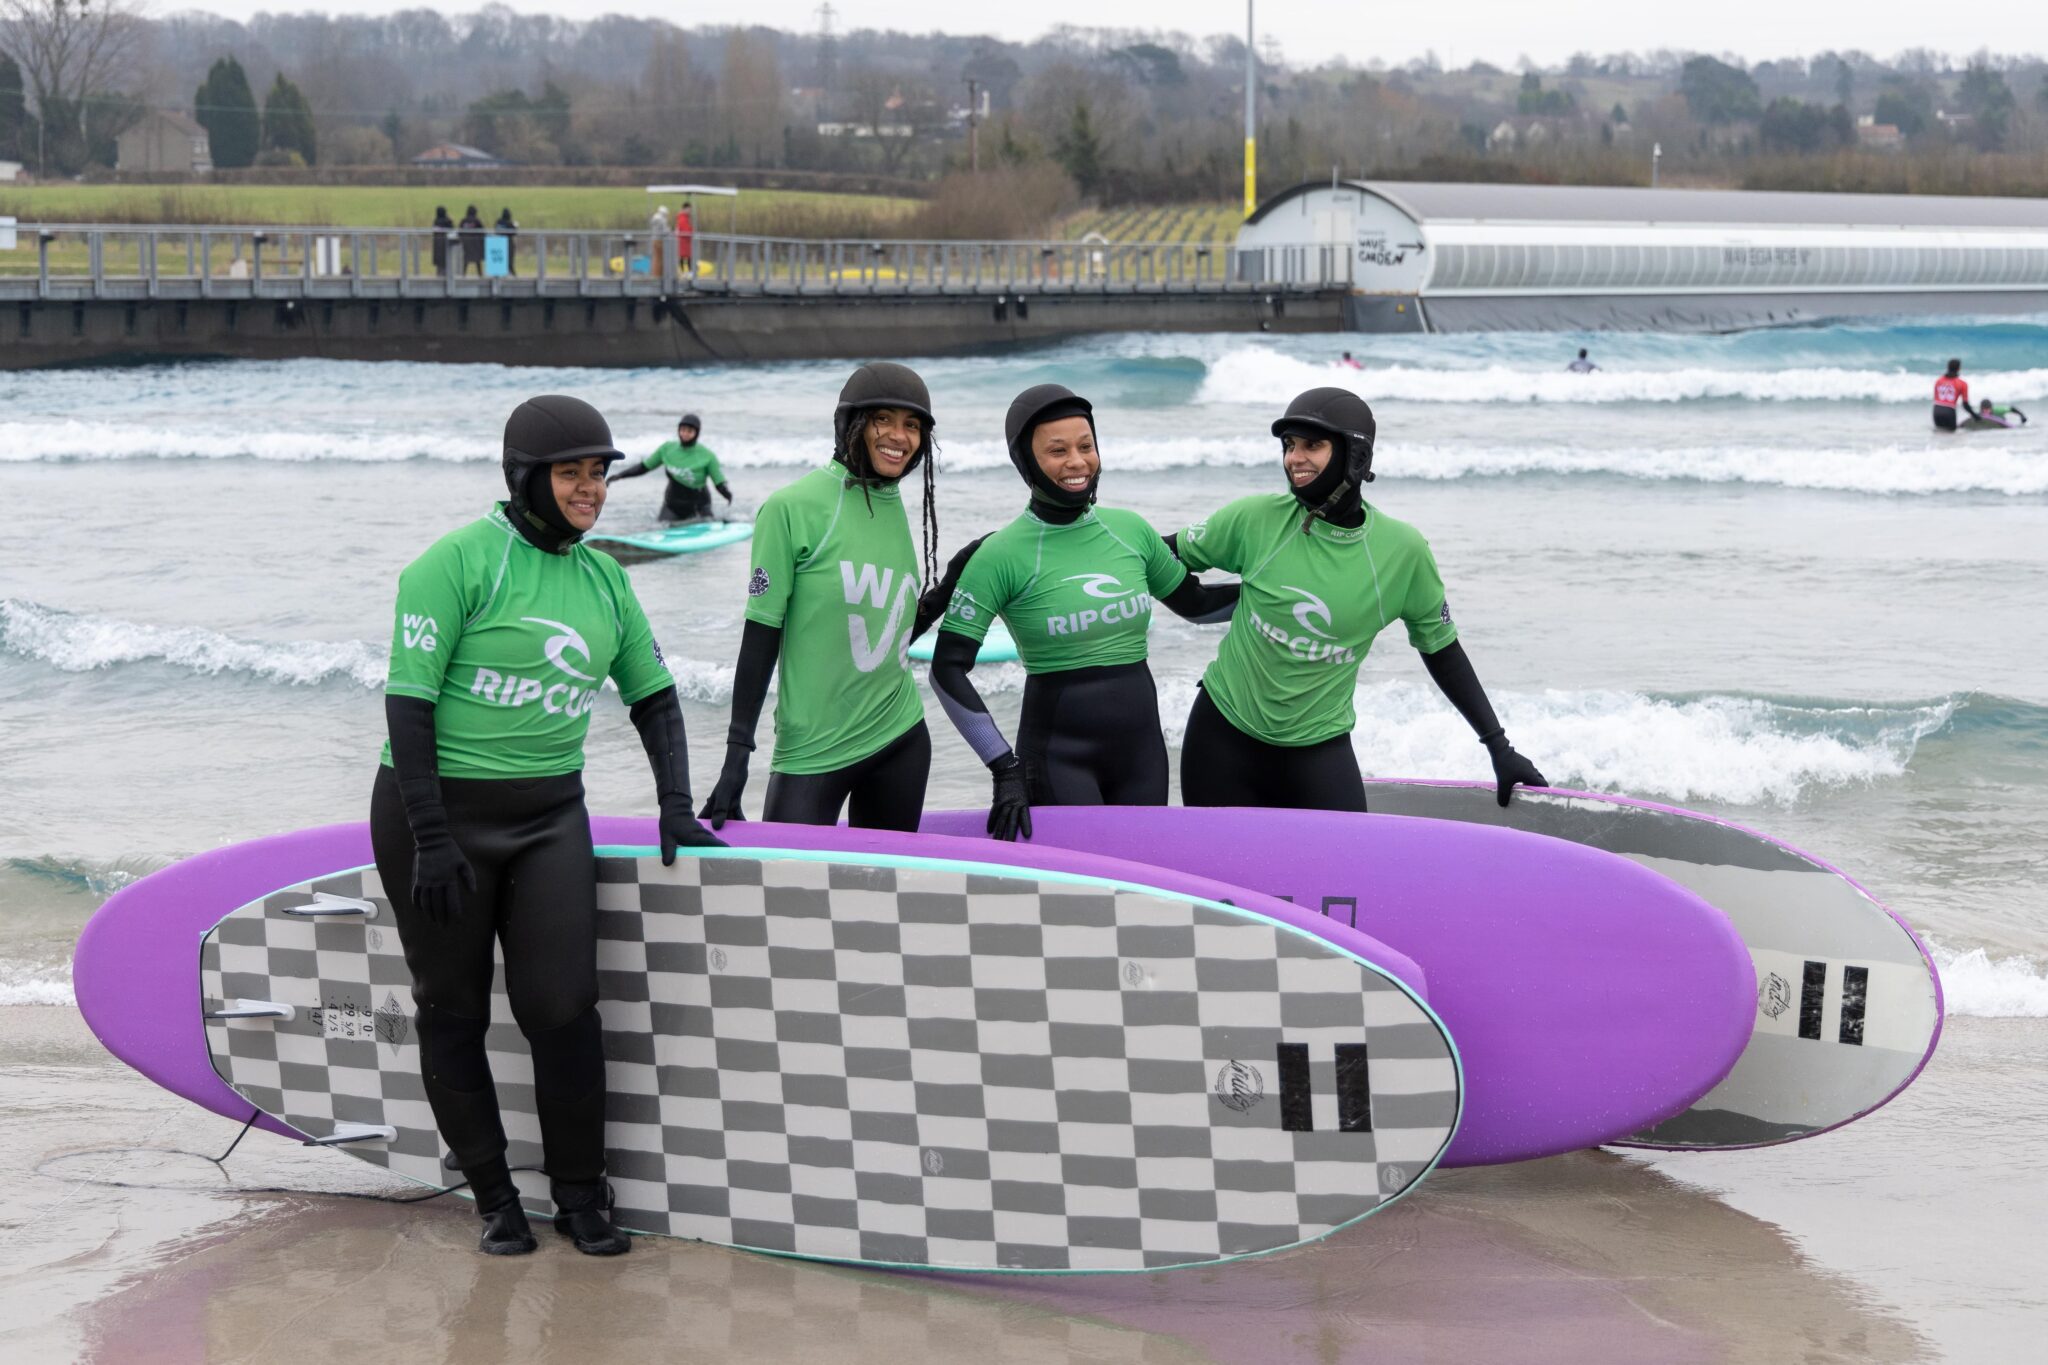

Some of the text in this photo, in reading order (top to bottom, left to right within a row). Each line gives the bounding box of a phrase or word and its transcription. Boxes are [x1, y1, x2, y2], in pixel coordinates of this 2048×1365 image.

[1047, 608, 1098, 636] RIP
[1250, 608, 1356, 665] RIP CURL
[470, 667, 543, 706] RIP
[312, 1006, 323, 1027] 147
[343, 1002, 355, 1017] 29
